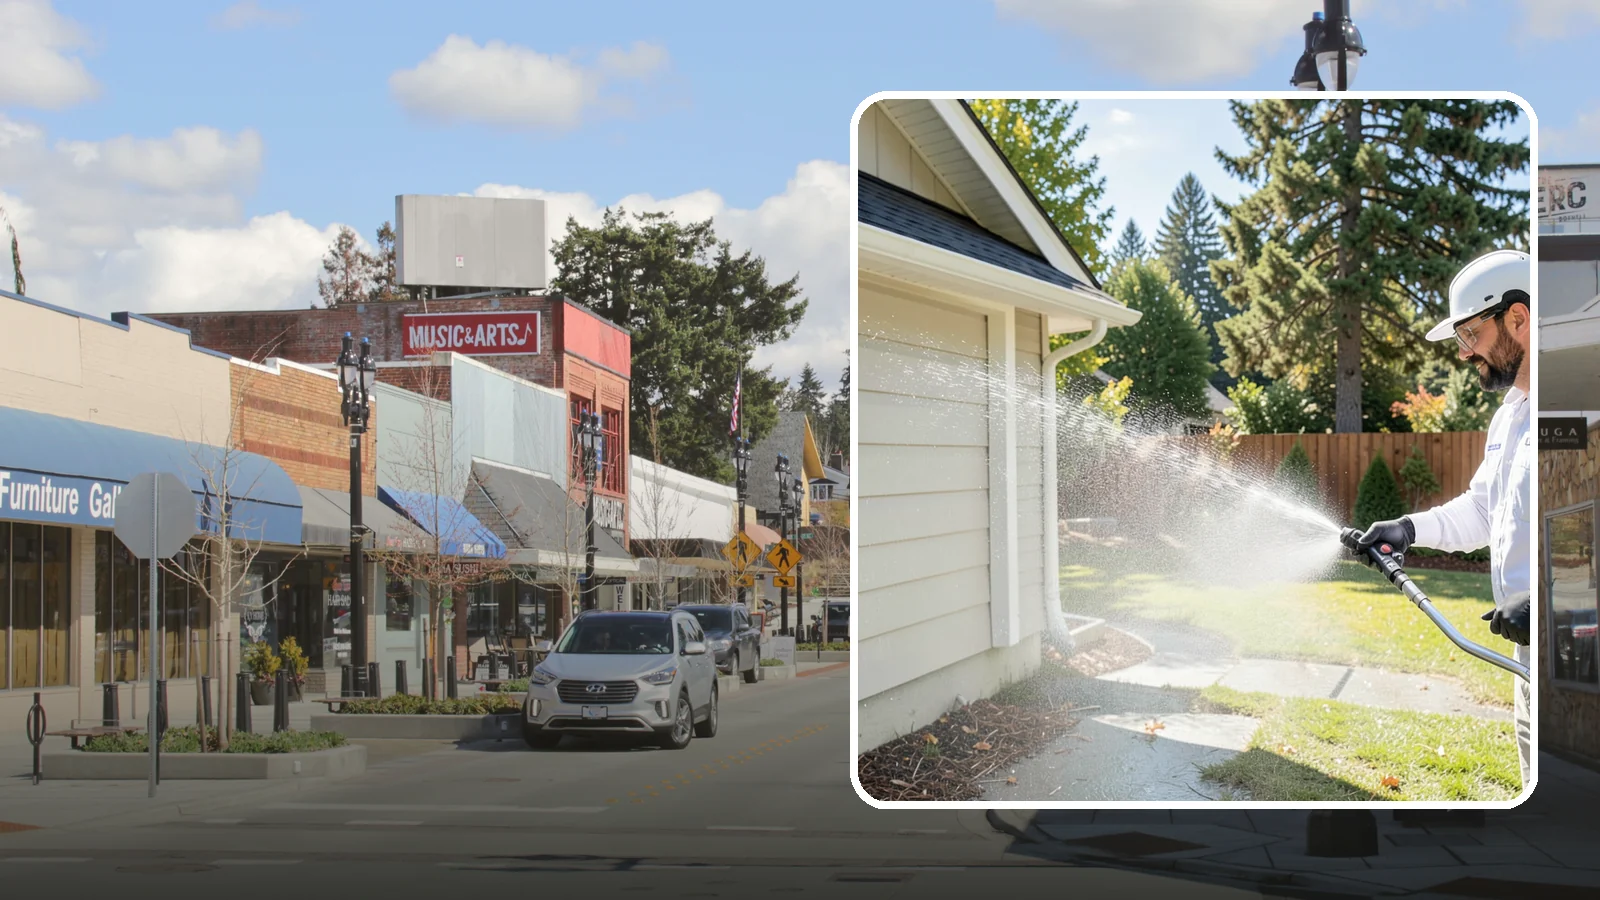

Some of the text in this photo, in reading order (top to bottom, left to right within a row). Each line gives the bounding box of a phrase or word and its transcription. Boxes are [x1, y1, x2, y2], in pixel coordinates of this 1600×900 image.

[1540, 427, 1577, 437] UGA
[0, 471, 79, 516] Furniture
[453, 563, 479, 575] SUSHI
